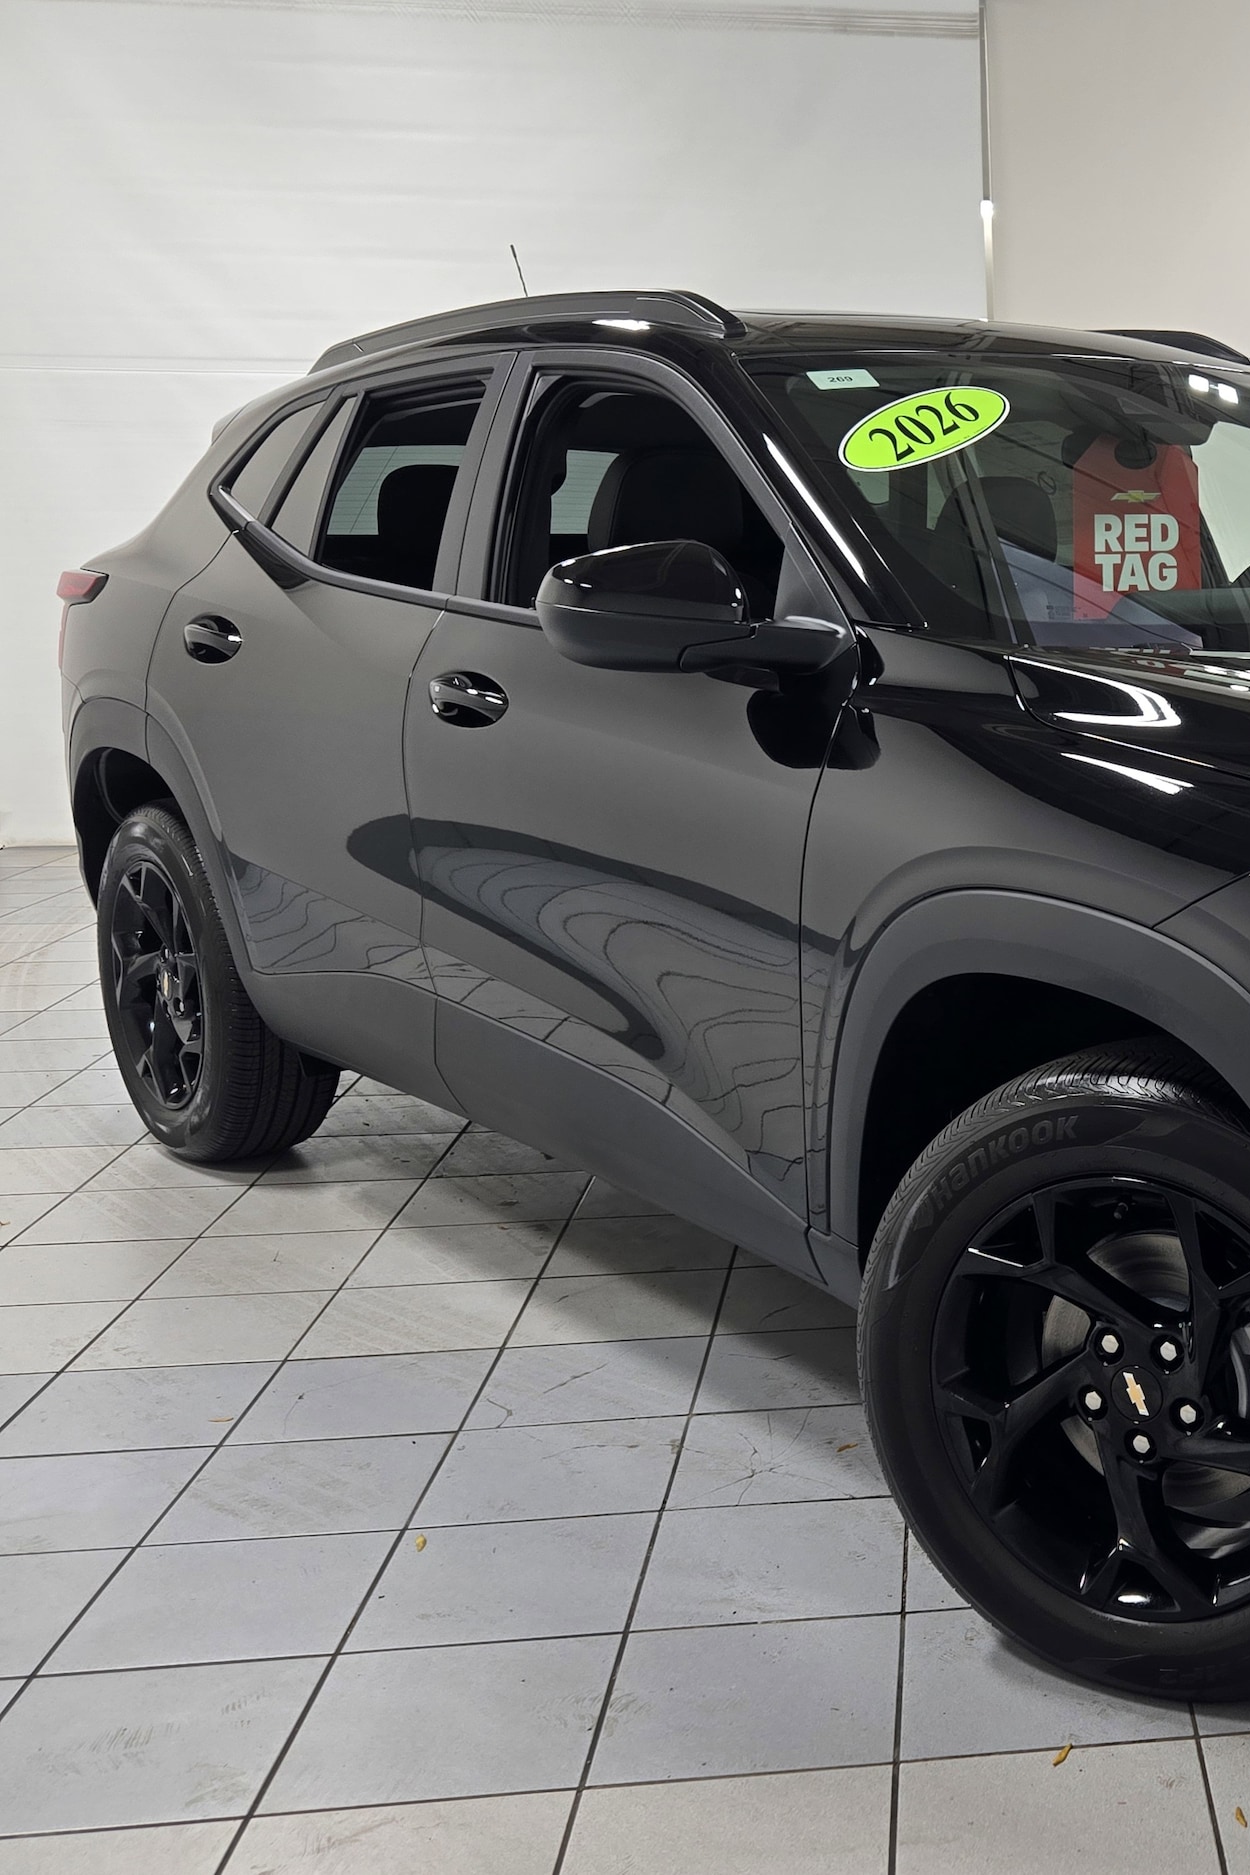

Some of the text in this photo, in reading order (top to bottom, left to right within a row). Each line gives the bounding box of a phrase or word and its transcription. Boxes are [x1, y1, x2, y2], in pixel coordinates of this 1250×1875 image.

[868, 391, 980, 462] 2026
[1093, 513, 1180, 553] RED
[1094, 552, 1178, 592] TAG
